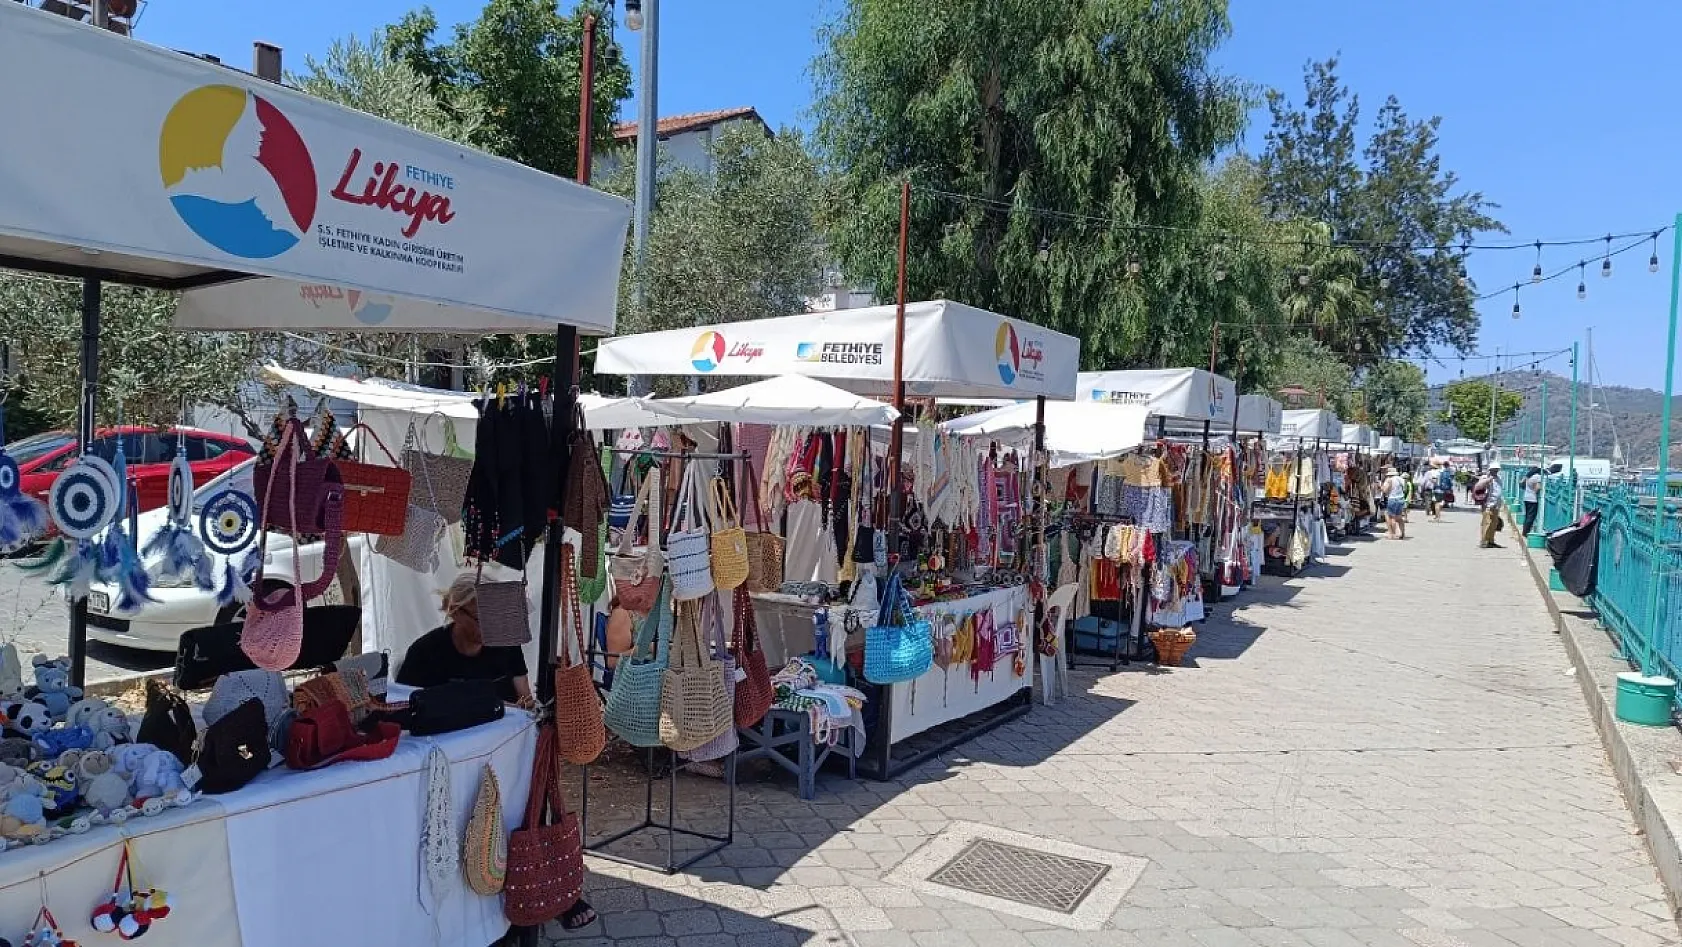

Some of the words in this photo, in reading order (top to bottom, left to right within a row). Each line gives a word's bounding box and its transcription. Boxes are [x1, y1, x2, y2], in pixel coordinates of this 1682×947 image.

[330, 147, 456, 239] Likya
[372, 235, 400, 250] KADIN
[356, 244, 369, 255] VE
[370, 246, 413, 265] KALKINMA
[727, 341, 765, 364] Likya
[822, 342, 884, 355] FETHİYE
[821, 352, 883, 366] BELEDİYESİ
